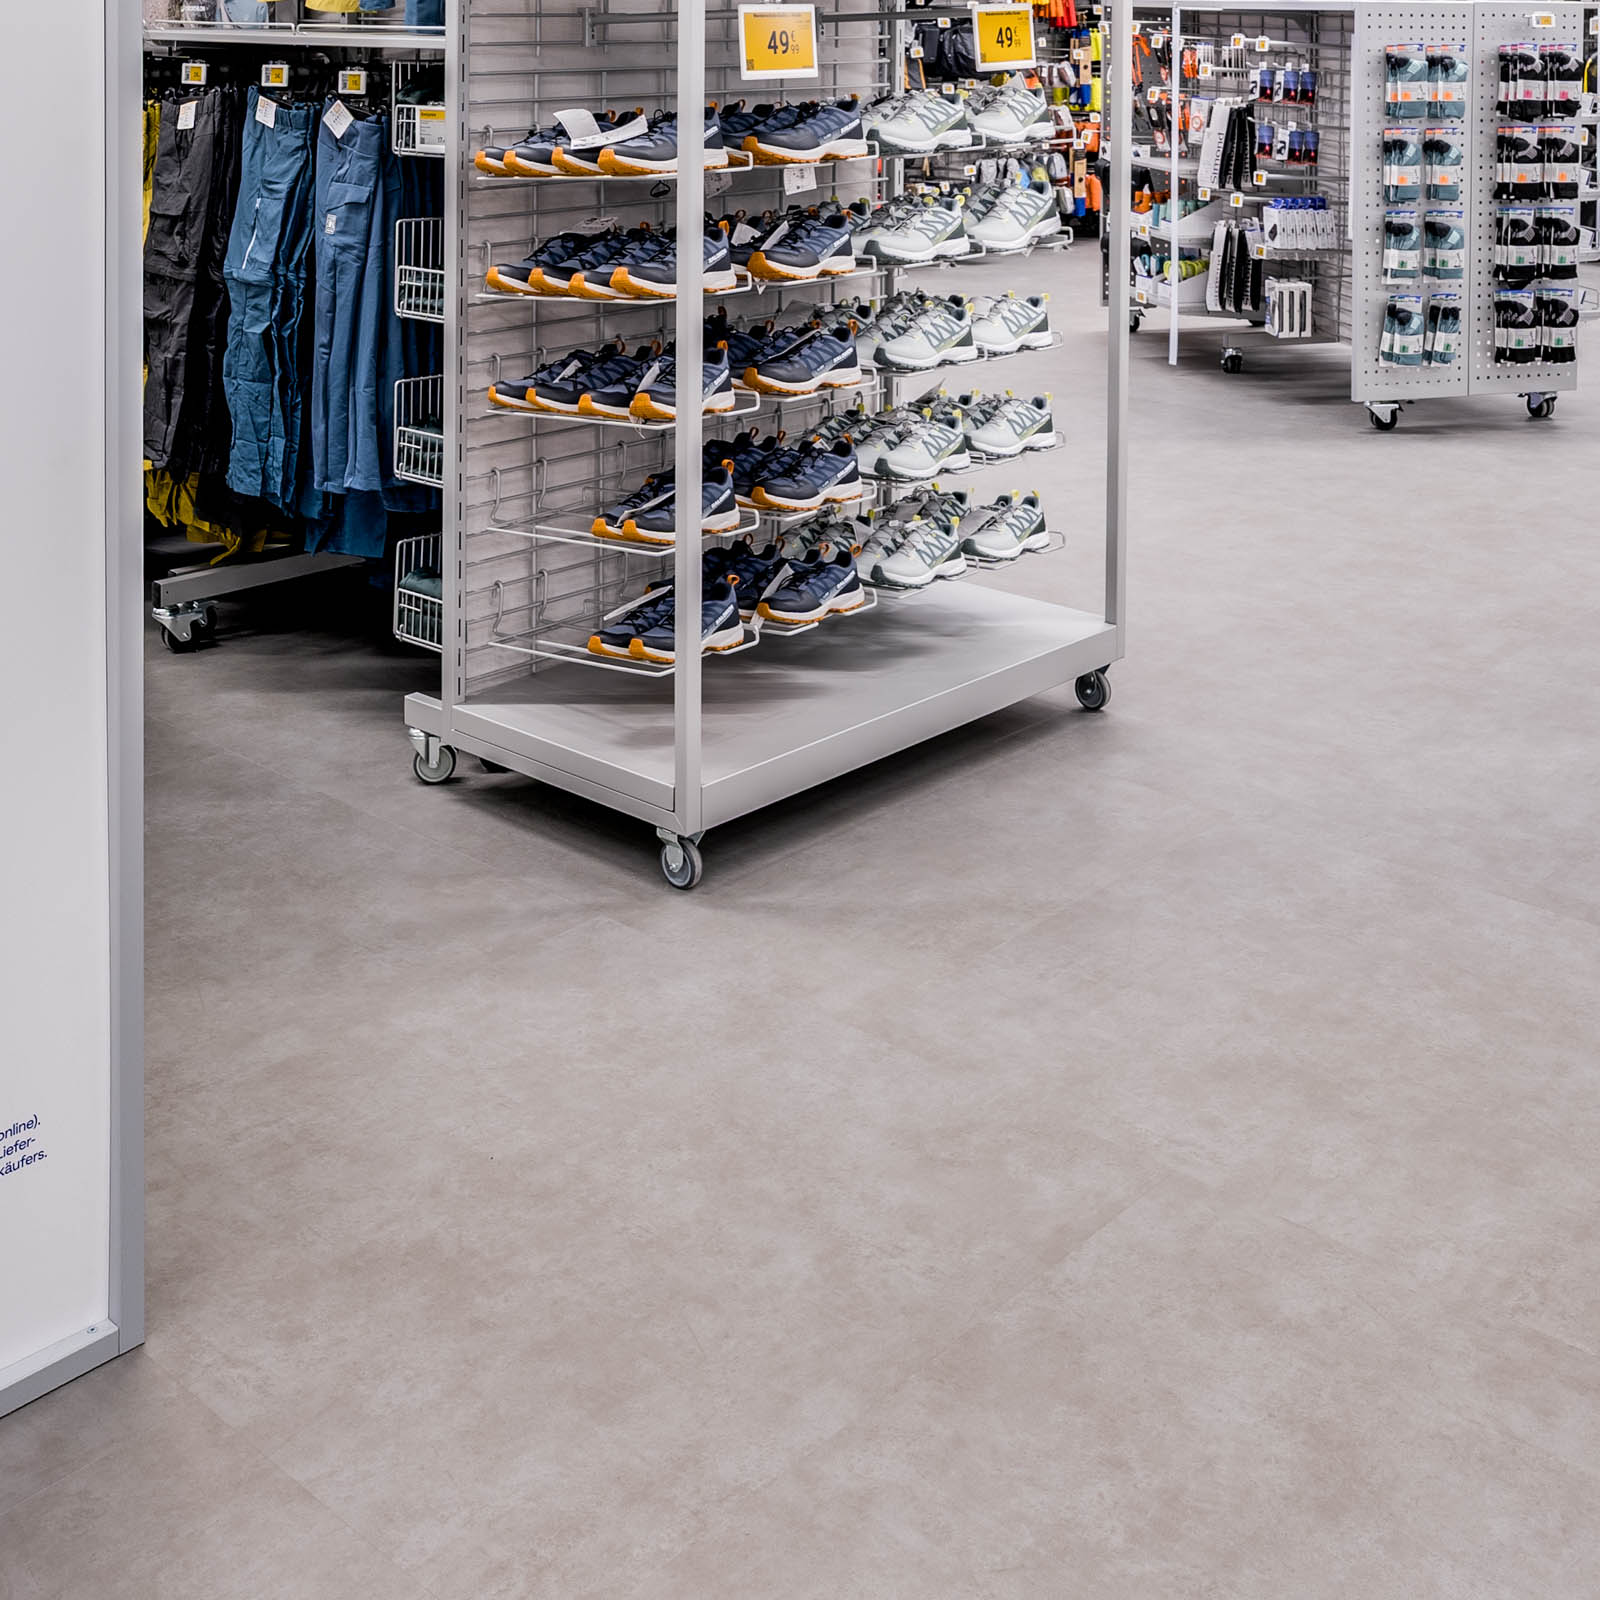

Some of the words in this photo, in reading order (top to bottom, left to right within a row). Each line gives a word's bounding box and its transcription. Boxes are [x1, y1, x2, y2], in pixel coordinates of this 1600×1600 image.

[767, 30, 789, 54] 49
[996, 26, 1013, 48] 49
[1211, 132, 1225, 184] Simond
